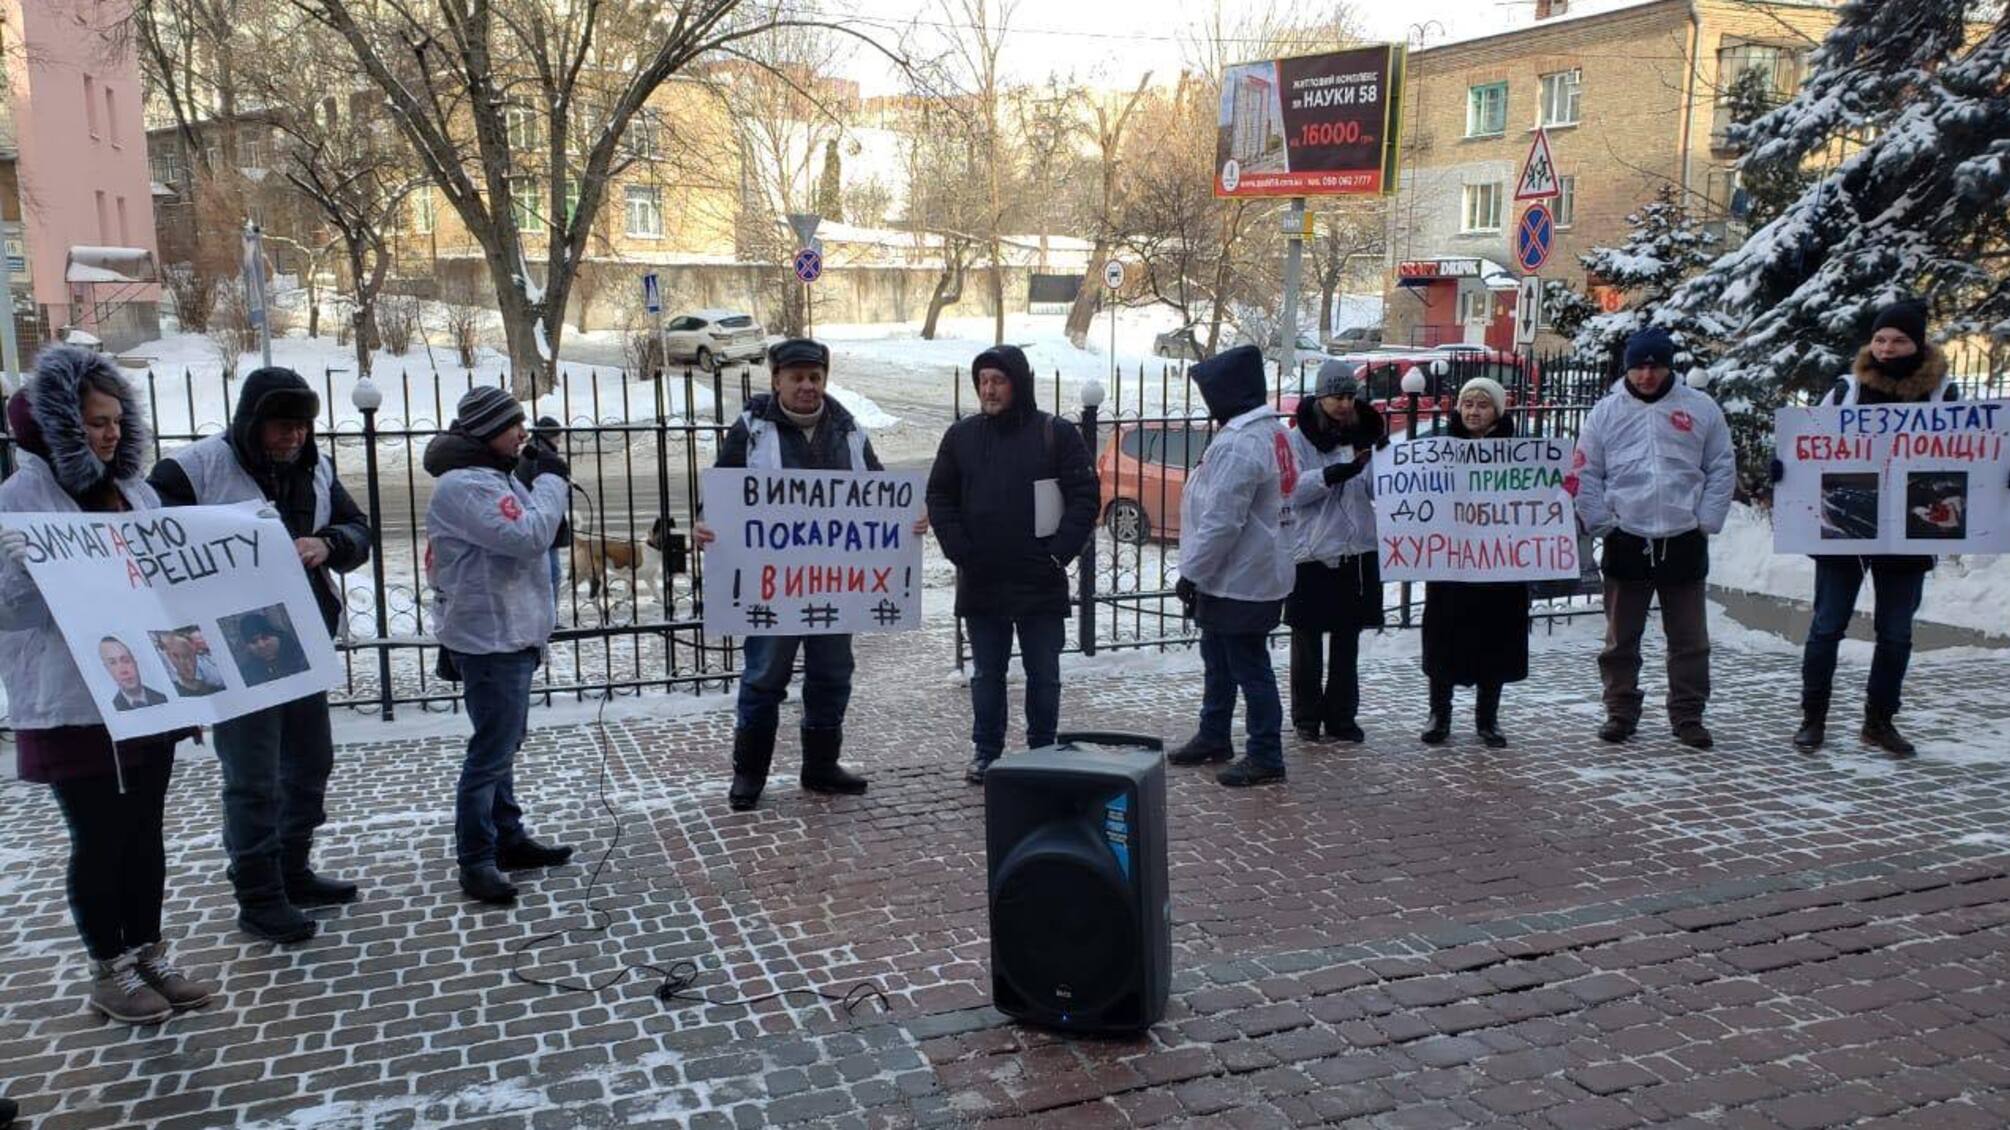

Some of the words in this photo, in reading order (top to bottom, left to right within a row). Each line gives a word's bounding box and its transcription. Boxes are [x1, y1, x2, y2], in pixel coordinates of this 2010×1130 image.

[1304, 86, 1355, 108] НАУКИ
[1359, 85, 1377, 104] 58
[1302, 121, 1359, 145] 16000
[1840, 404, 2002, 434] РЕЗУЛЬТАТ
[743, 476, 913, 507] ВИМАГАЄМО
[1469, 467, 1564, 492] ПРИВЕЛА
[1390, 500, 1435, 523] ДО
[745, 520, 900, 551] ПОКАРАТИ
[126, 530, 259, 588] АРЕШТУ
[761, 565, 892, 601] ВИННИХ
